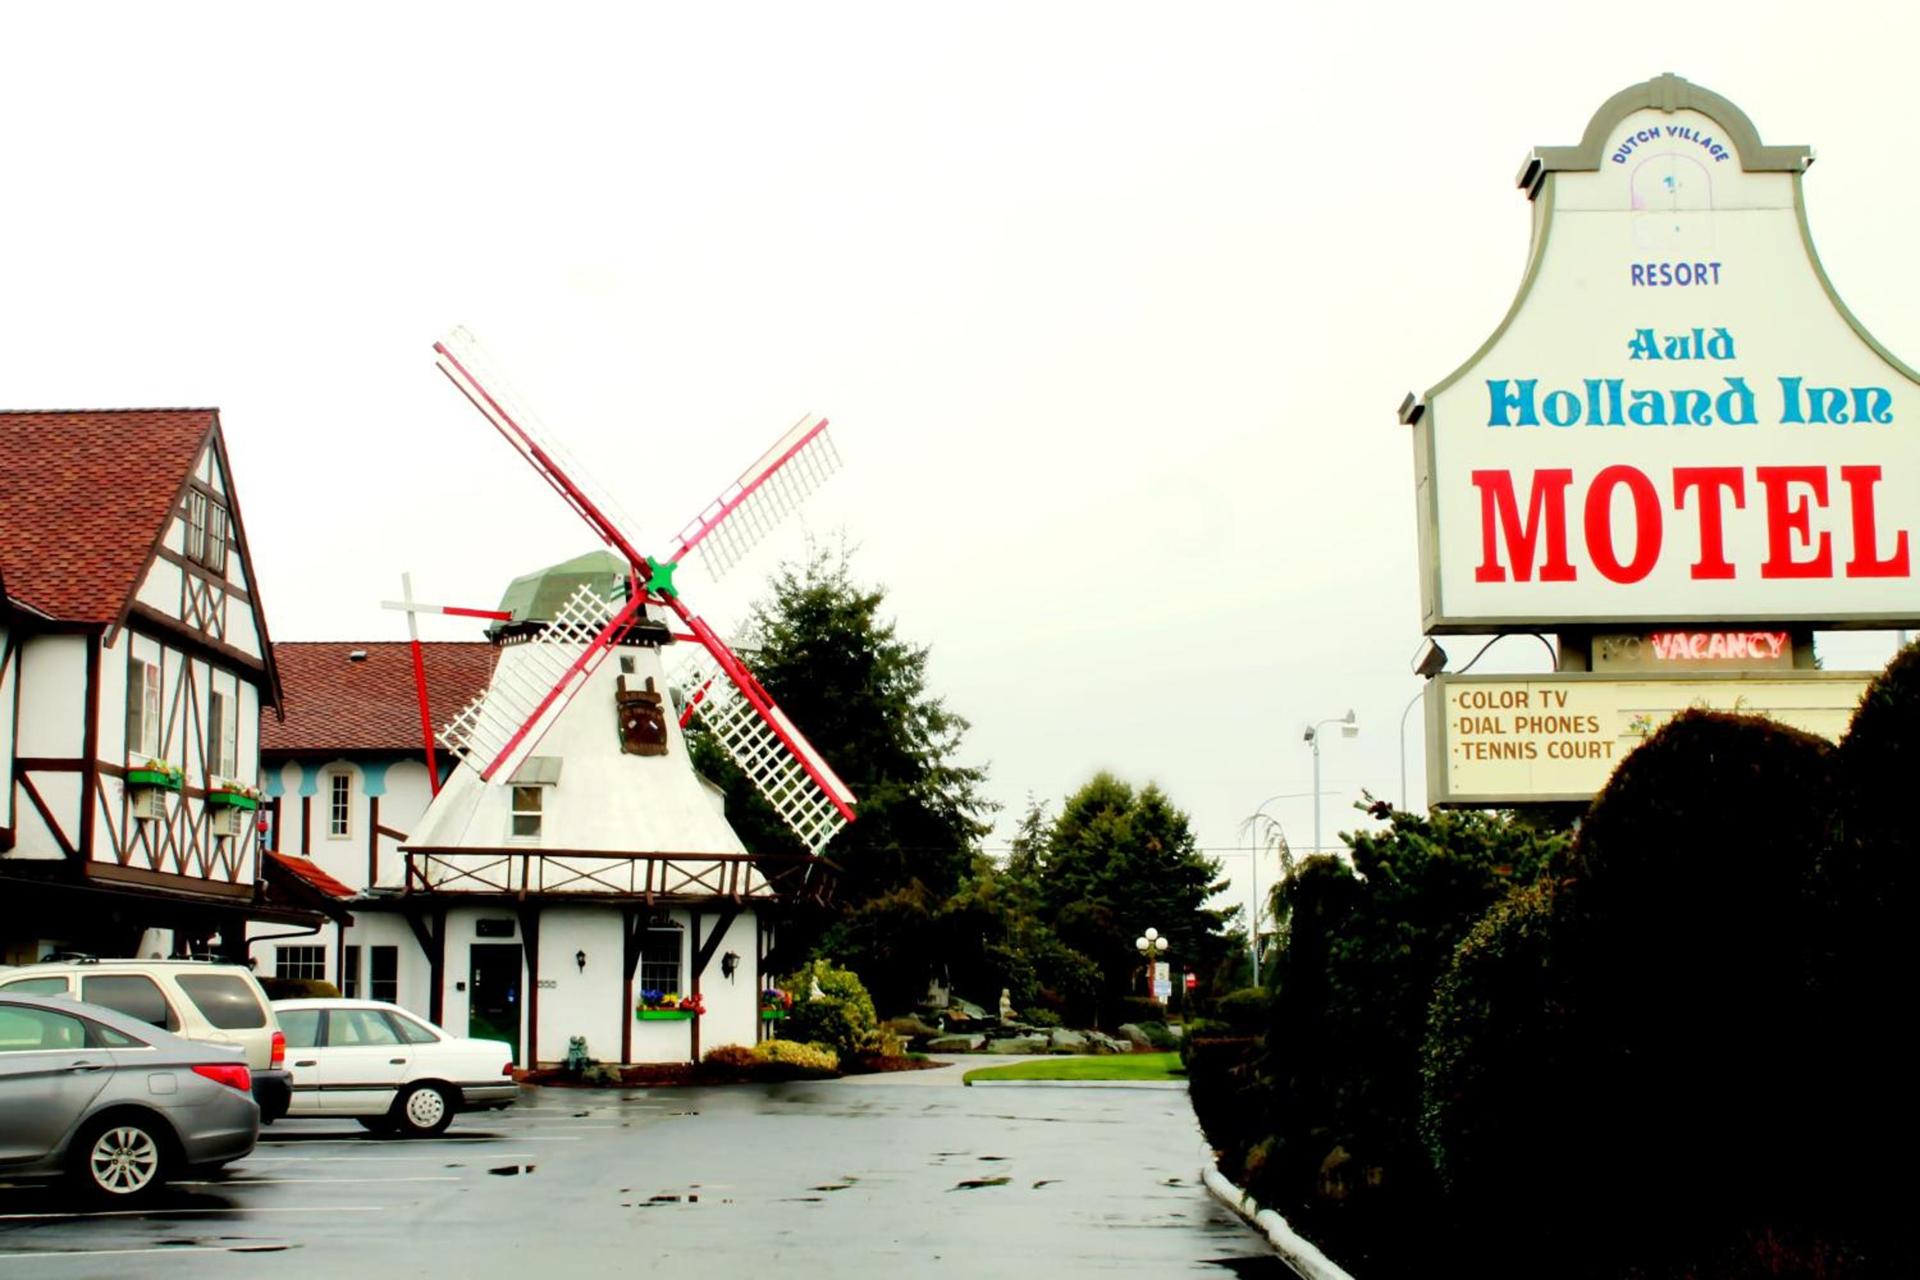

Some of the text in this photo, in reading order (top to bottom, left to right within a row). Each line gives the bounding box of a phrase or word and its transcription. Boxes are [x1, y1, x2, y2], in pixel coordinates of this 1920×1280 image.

[1612, 126, 1729, 164] DUTCH VILLAGE
[1631, 262, 1722, 287] RESORT
[1627, 326, 1737, 362] Auld
[1486, 375, 1895, 428] Holland Inn
[1471, 464, 1911, 584] MOTEL
[1651, 631, 1786, 660] VACANCY
[1458, 690, 1569, 710] COLOR TV
[1460, 715, 1600, 735] DIAL PHONES
[1461, 740, 1615, 761] TENNIS COURT
